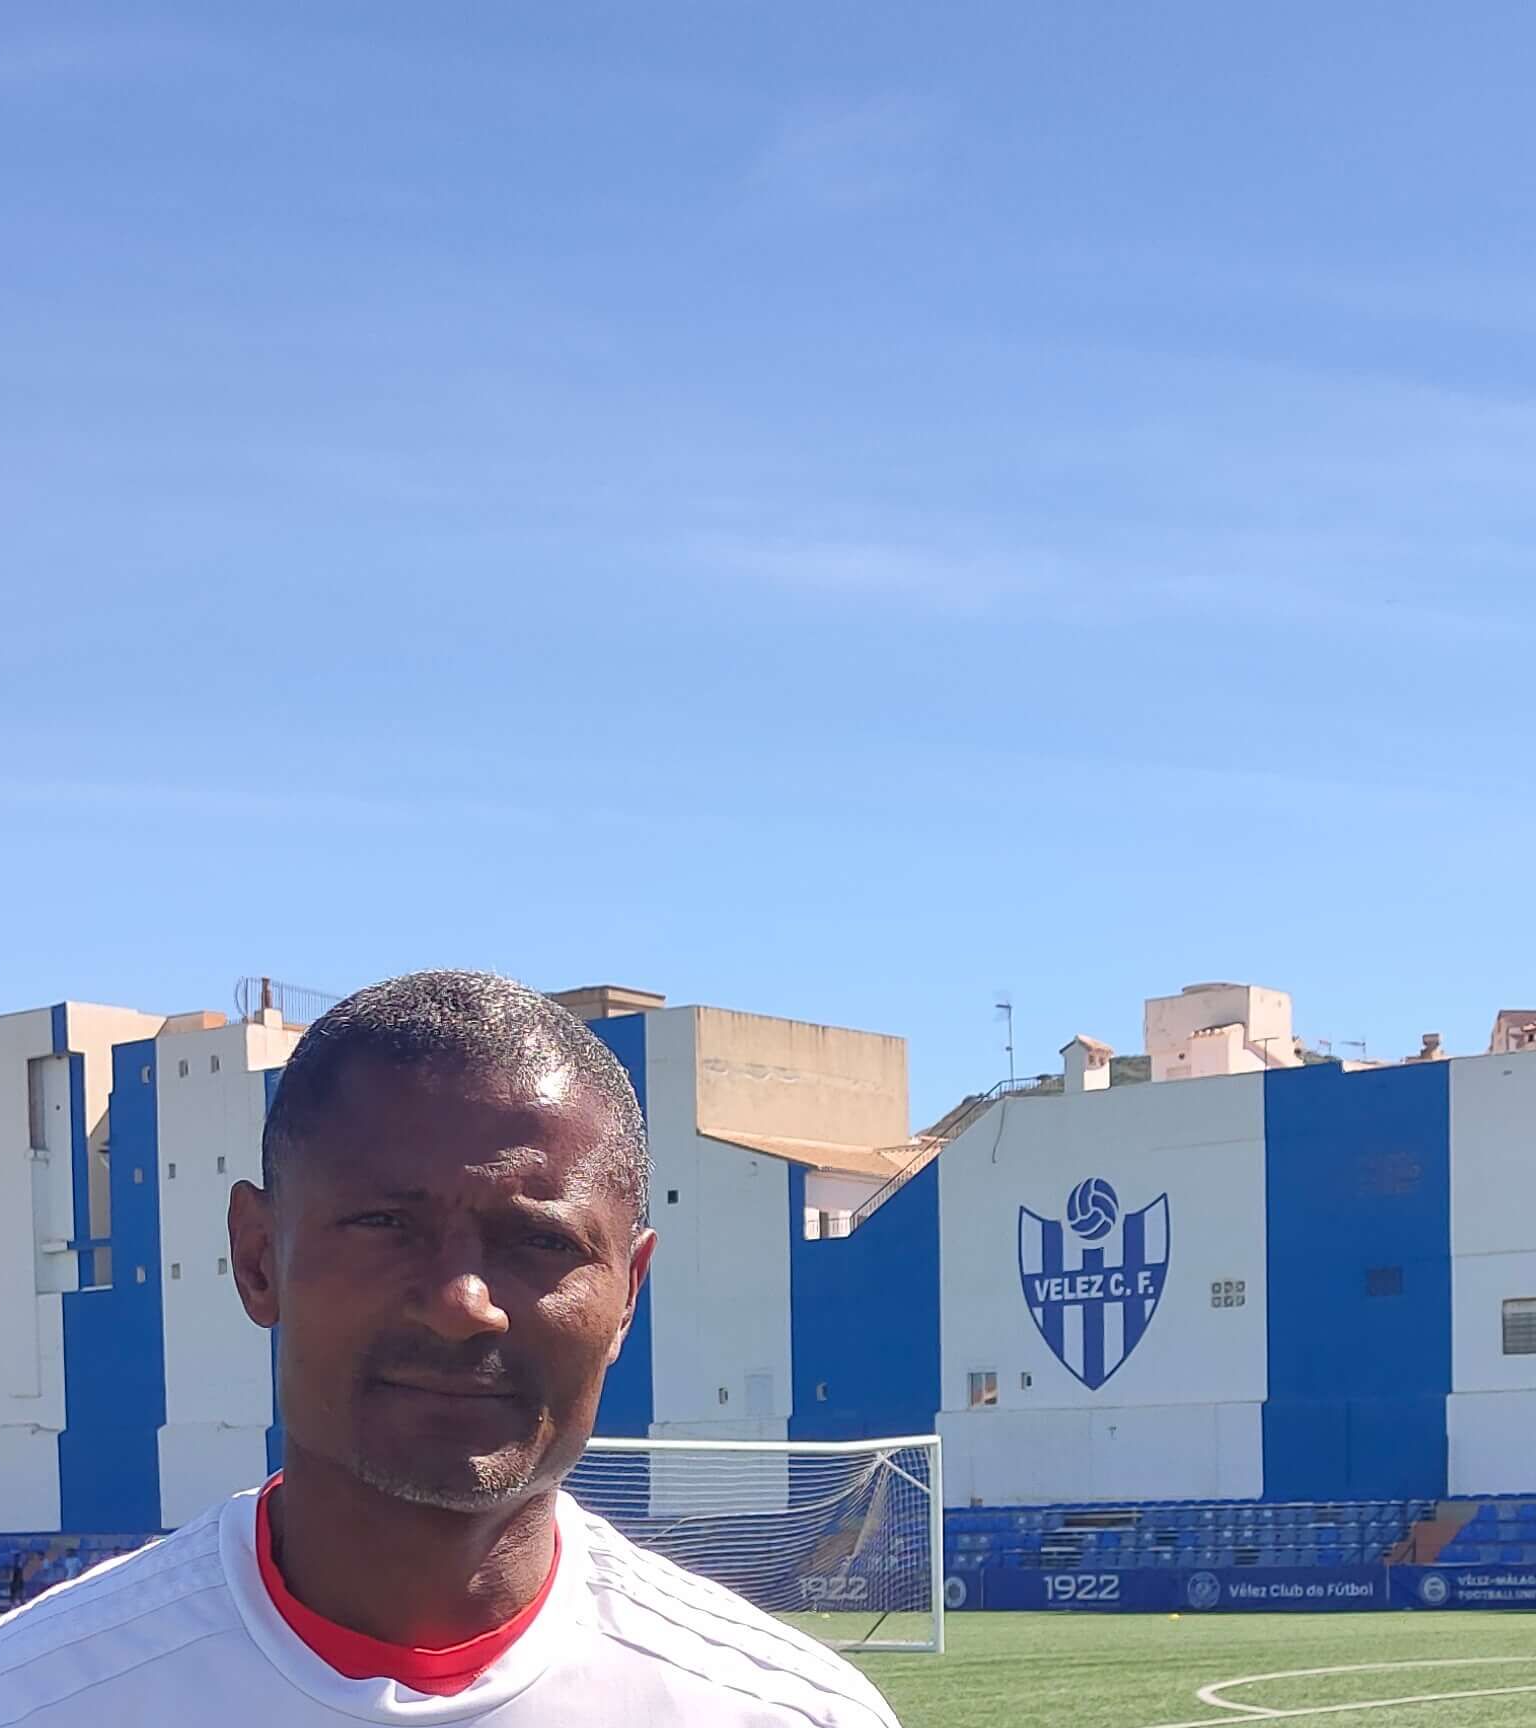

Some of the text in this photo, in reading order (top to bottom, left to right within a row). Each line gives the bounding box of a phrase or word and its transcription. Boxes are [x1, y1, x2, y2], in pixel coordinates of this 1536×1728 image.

[1034, 1275, 1104, 1302] VELEZ
[799, 1577, 868, 1600] 1922
[1043, 1574, 1120, 1600] 1922
[1269, 1583, 1304, 1598] Club
[1306, 1583, 1324, 1597] de
[1327, 1581, 1374, 1597] Fútbol
